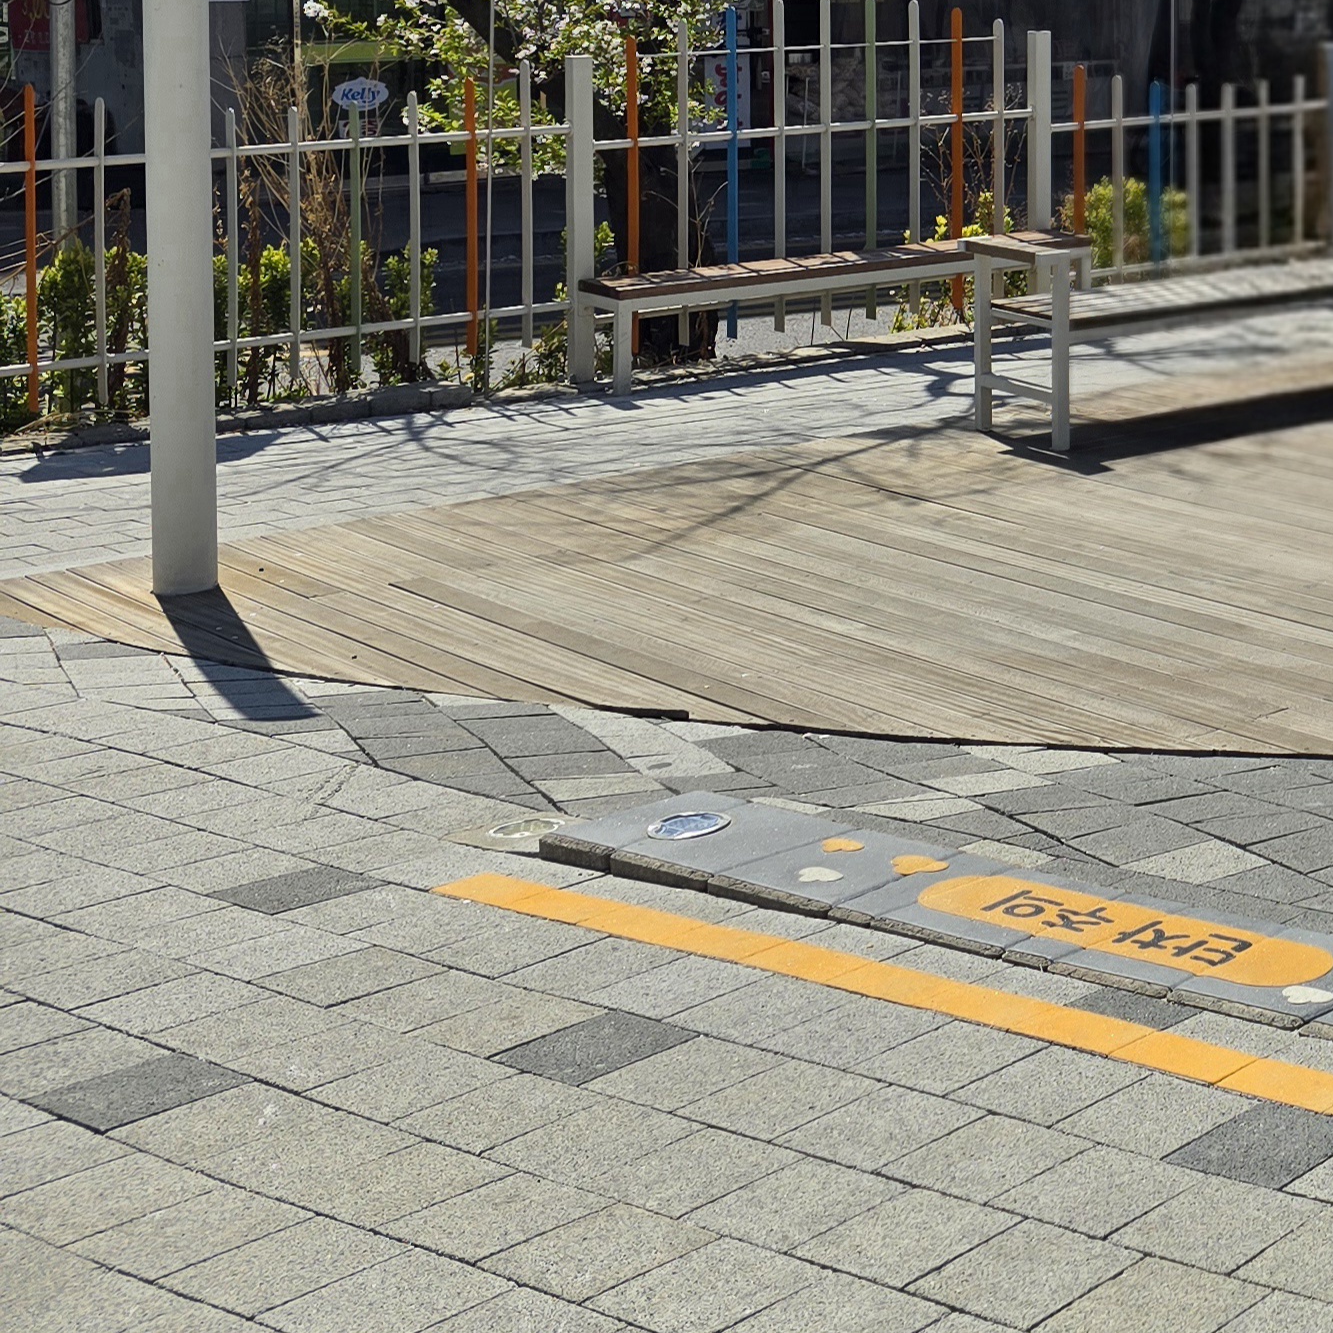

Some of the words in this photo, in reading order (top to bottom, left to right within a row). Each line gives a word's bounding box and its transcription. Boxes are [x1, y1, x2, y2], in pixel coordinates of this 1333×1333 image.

[341, 87, 380, 104] Kelly
[981, 890, 1115, 934] 주의
[1112, 920, 1253, 967] 단차
